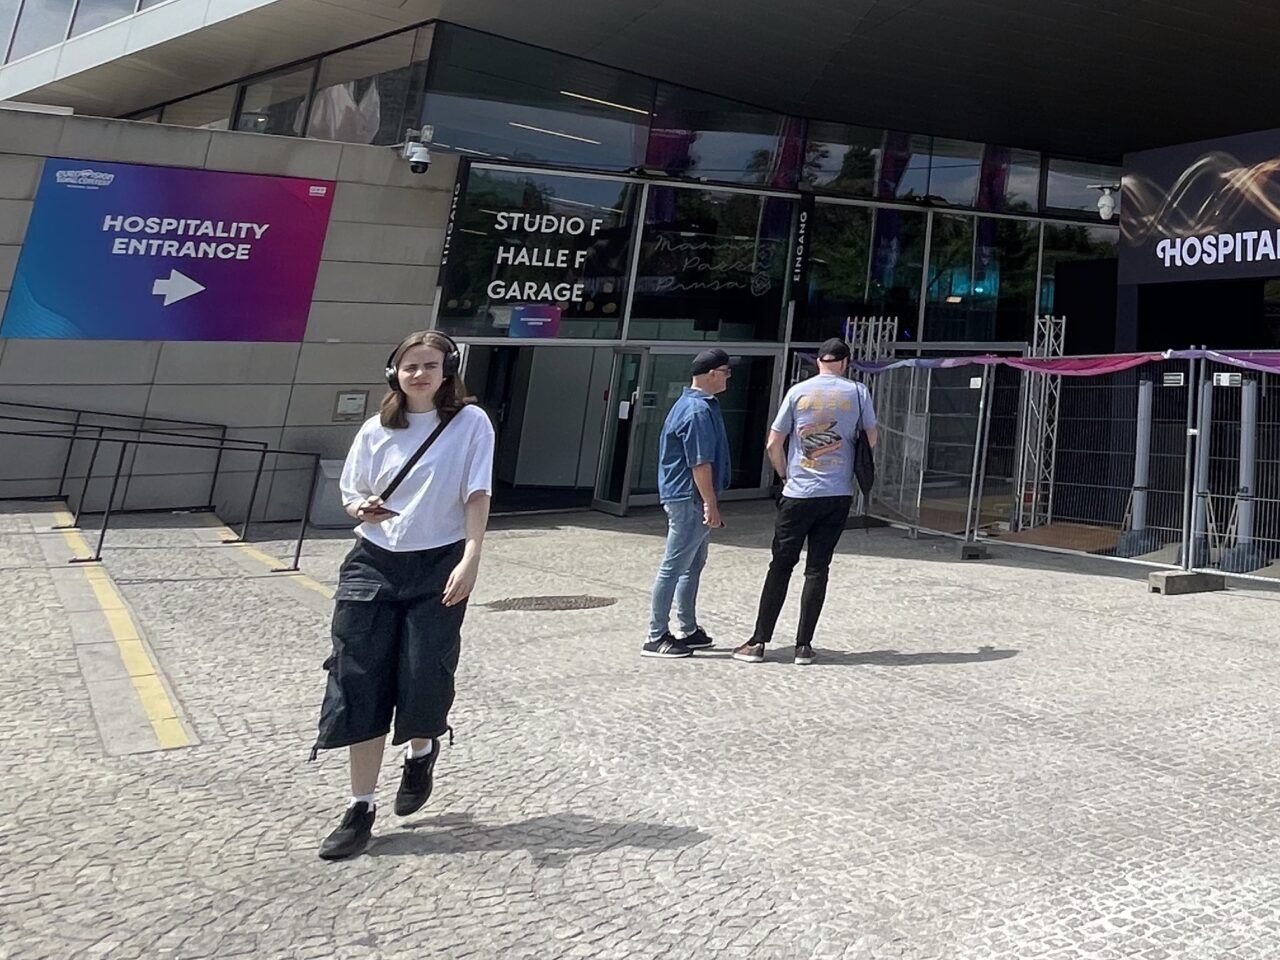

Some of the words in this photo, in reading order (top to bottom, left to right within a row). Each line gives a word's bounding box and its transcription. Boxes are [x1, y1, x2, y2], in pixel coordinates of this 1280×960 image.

[102, 214, 270, 240] HOSPITALITY
[494, 212, 585, 236] STUDIO
[590, 218, 604, 237] F
[111, 238, 252, 261] ENTRANCE
[496, 245, 569, 268] HALLE
[574, 250, 588, 269] F
[793, 210, 808, 282] EINGANG
[486, 280, 585, 302] GARAGE
